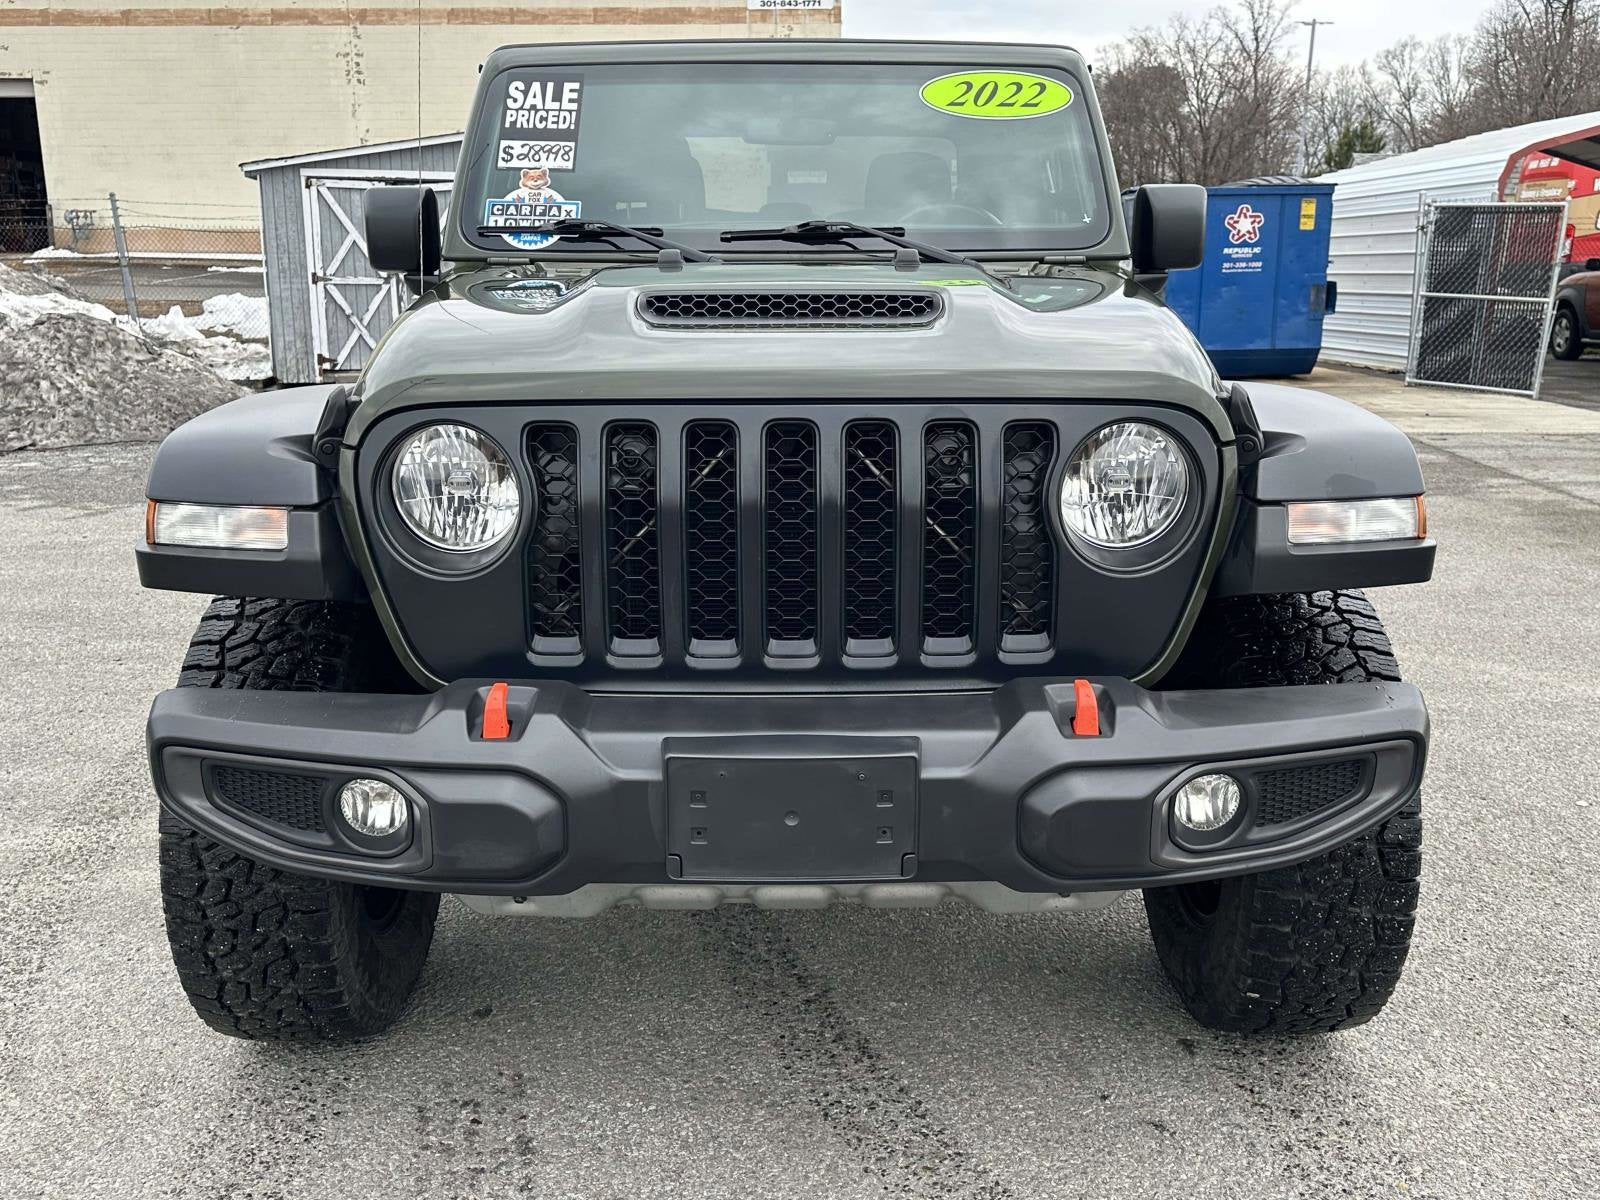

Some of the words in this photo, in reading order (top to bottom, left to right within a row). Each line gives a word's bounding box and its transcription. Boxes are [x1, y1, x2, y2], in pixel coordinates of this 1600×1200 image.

[506, 81, 580, 111] SALE
[945, 80, 1047, 108] 2022
[504, 110, 577, 130] PRICED!
[493, 205, 573, 218] CARFAX
[1223, 247, 1262, 255] REPUBLIC
